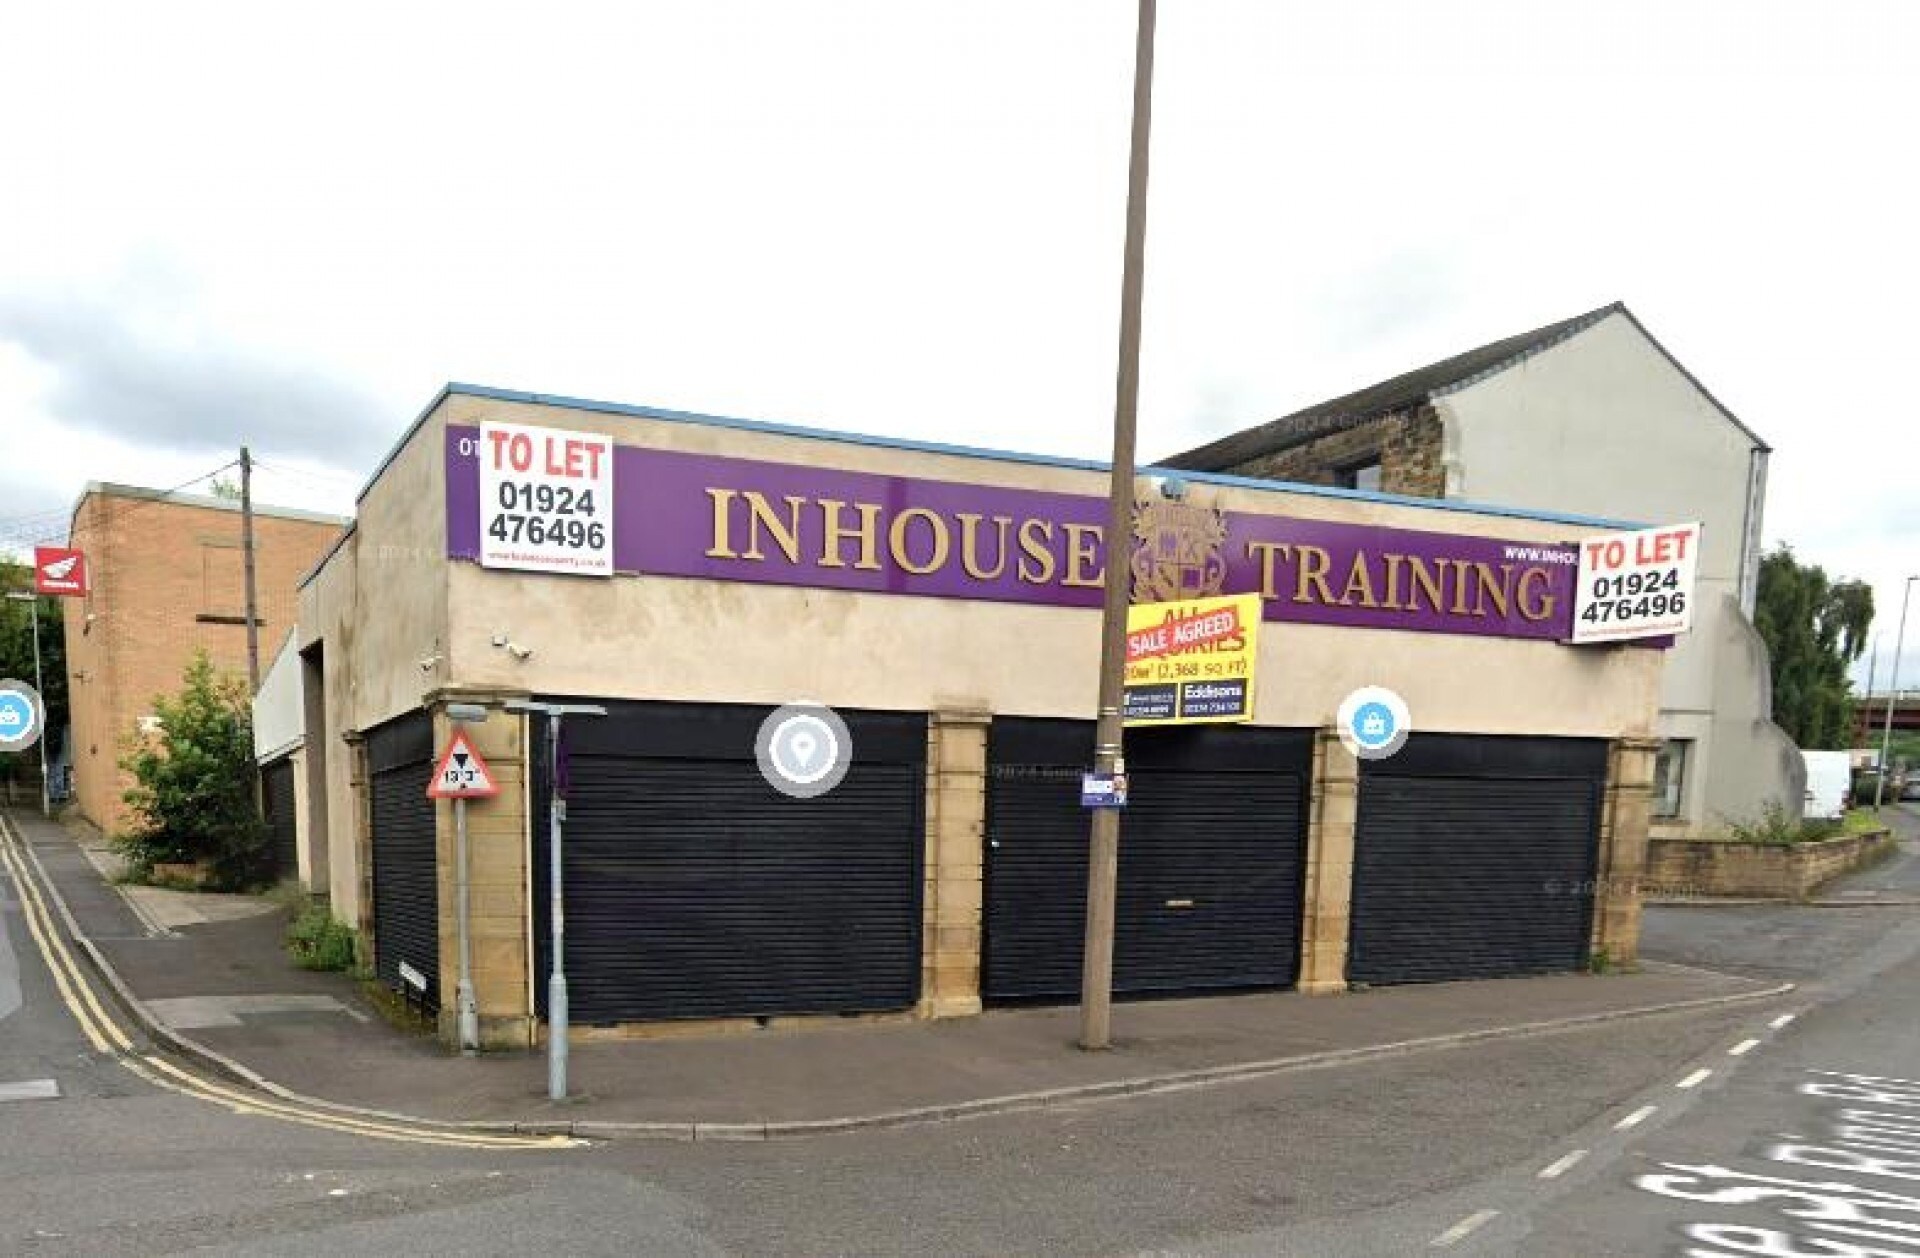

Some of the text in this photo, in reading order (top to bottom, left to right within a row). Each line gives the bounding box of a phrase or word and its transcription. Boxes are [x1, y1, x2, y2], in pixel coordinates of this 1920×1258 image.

[487, 430, 606, 480] TO LET
[499, 480, 595, 517] 01924
[489, 513, 606, 551] 476496
[1587, 530, 1692, 570] TO LET
[1245, 541, 1555, 622] TRAINING
[1593, 567, 1678, 599] 01924
[1581, 591, 1686, 624] 476496
[1128, 628, 1168, 657] SALE
[1173, 610, 1234, 646] AGREED
[1204, 662, 1223, 676] SQ
